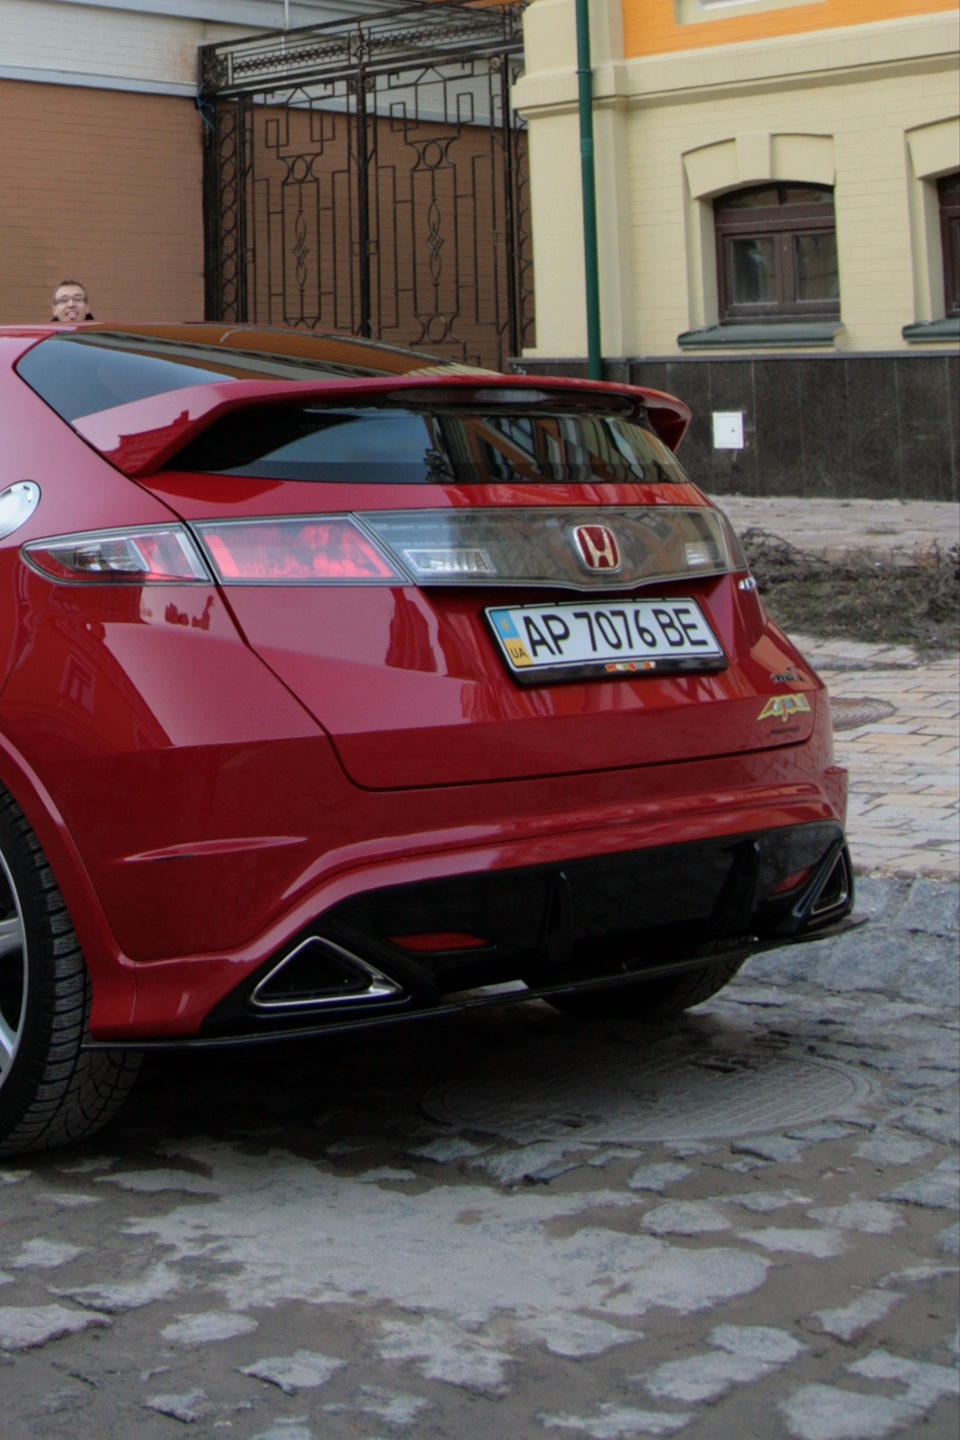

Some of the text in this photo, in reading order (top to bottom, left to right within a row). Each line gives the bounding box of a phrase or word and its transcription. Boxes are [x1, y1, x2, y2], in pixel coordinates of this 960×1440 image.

[522, 608, 709, 657] AP 7076 BE
[509, 647, 528, 659] UA
